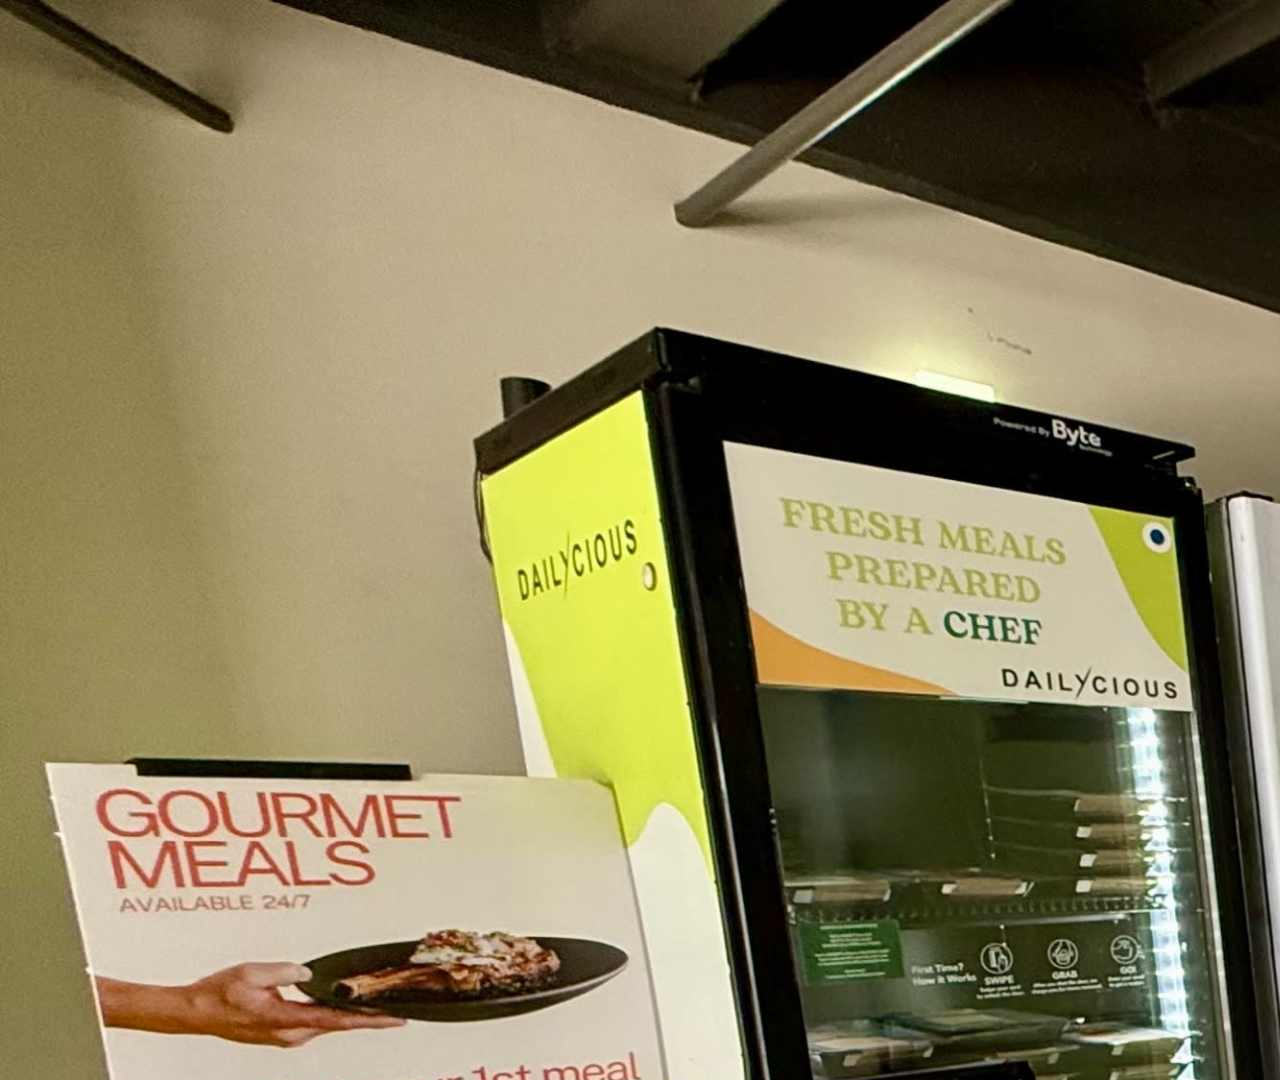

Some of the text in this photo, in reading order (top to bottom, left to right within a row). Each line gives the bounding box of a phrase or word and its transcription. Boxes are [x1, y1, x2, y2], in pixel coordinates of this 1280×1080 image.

[1051, 418, 1102, 447] Byte
[779, 497, 1067, 566] FRESH MEALS
[517, 518, 638, 602] DAILYCIOUS
[824, 550, 1042, 604] PREPARED
[836, 598, 1043, 645] BY A CHEF
[1001, 666, 1178, 700] DAILYCIOUS
[95, 788, 462, 839] GOURMET
[107, 840, 376, 890] MEALS
[119, 893, 312, 913] AVAILABLE 24/7
[984, 975, 1014, 986] SWIPE
[1051, 970, 1078, 980] GRAB
